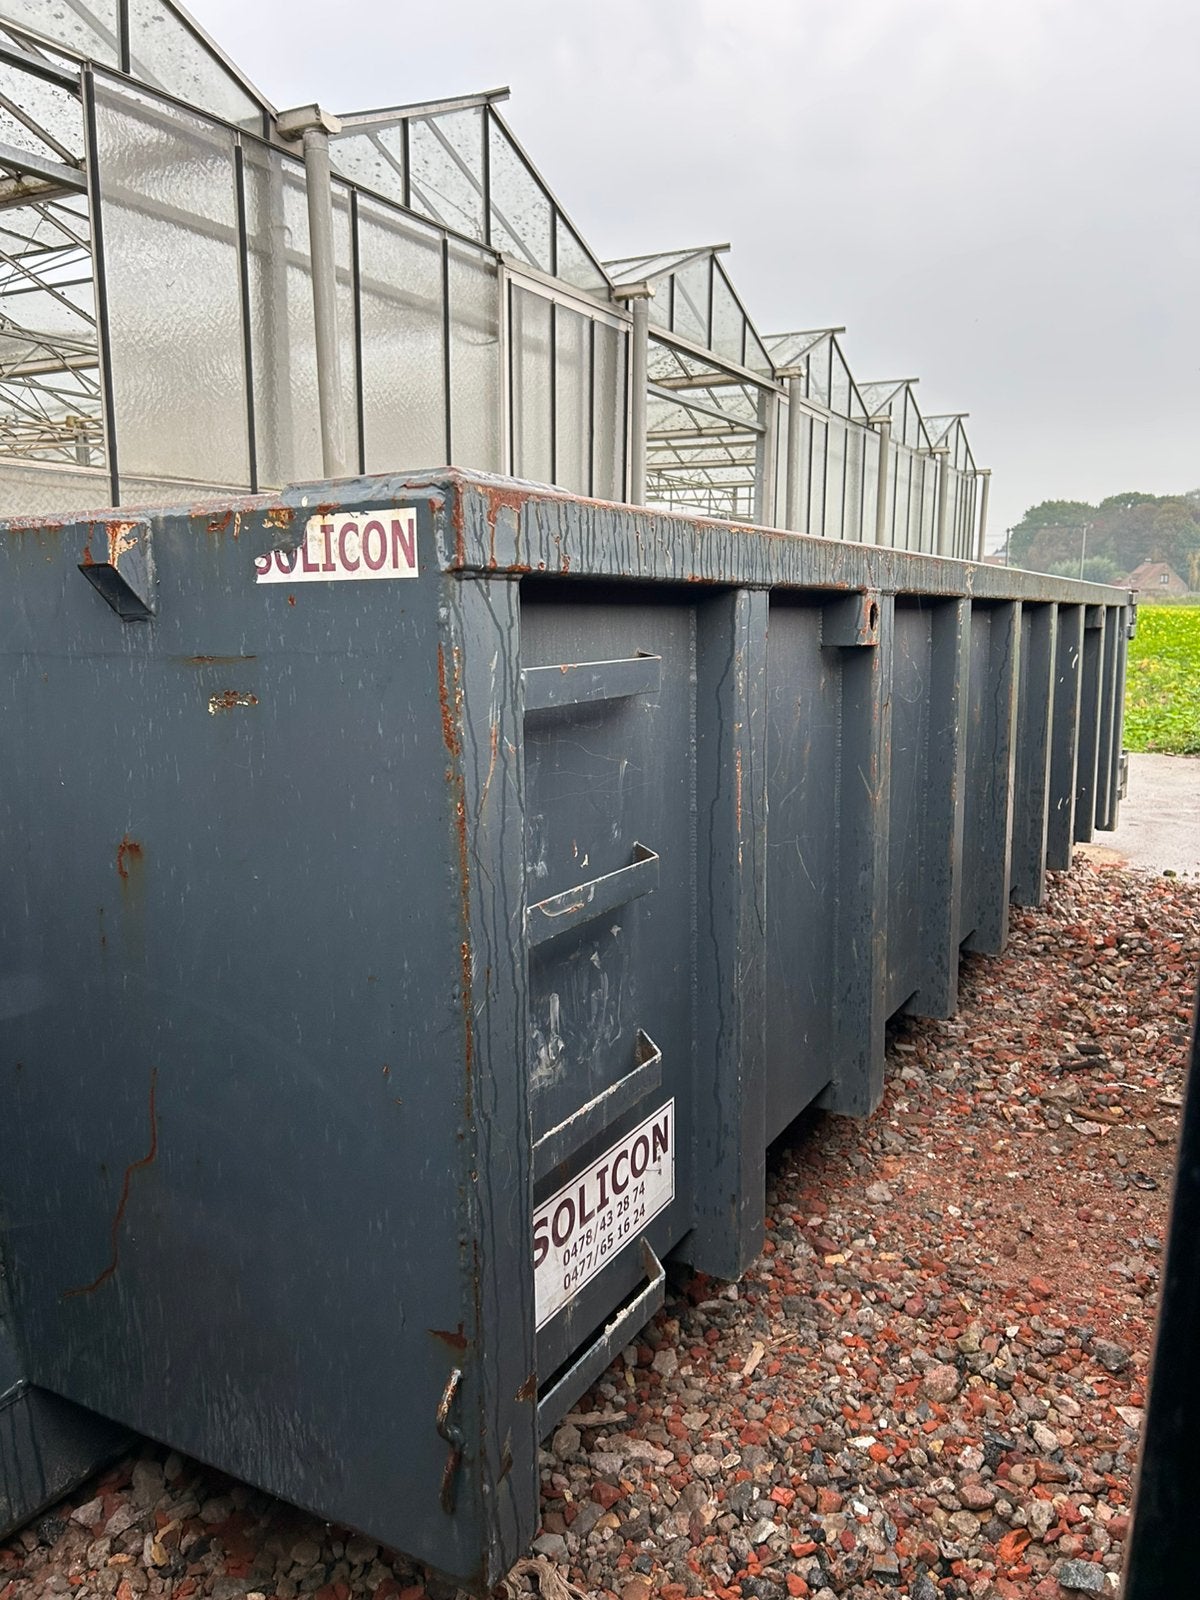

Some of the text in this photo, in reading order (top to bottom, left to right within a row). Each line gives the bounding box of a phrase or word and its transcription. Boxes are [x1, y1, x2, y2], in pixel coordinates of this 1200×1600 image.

[533, 1115, 669, 1270] SOLICON
[562, 1181, 646, 1266] 0478/43 28 74
[563, 1203, 646, 1291] 0477/65 16 24
